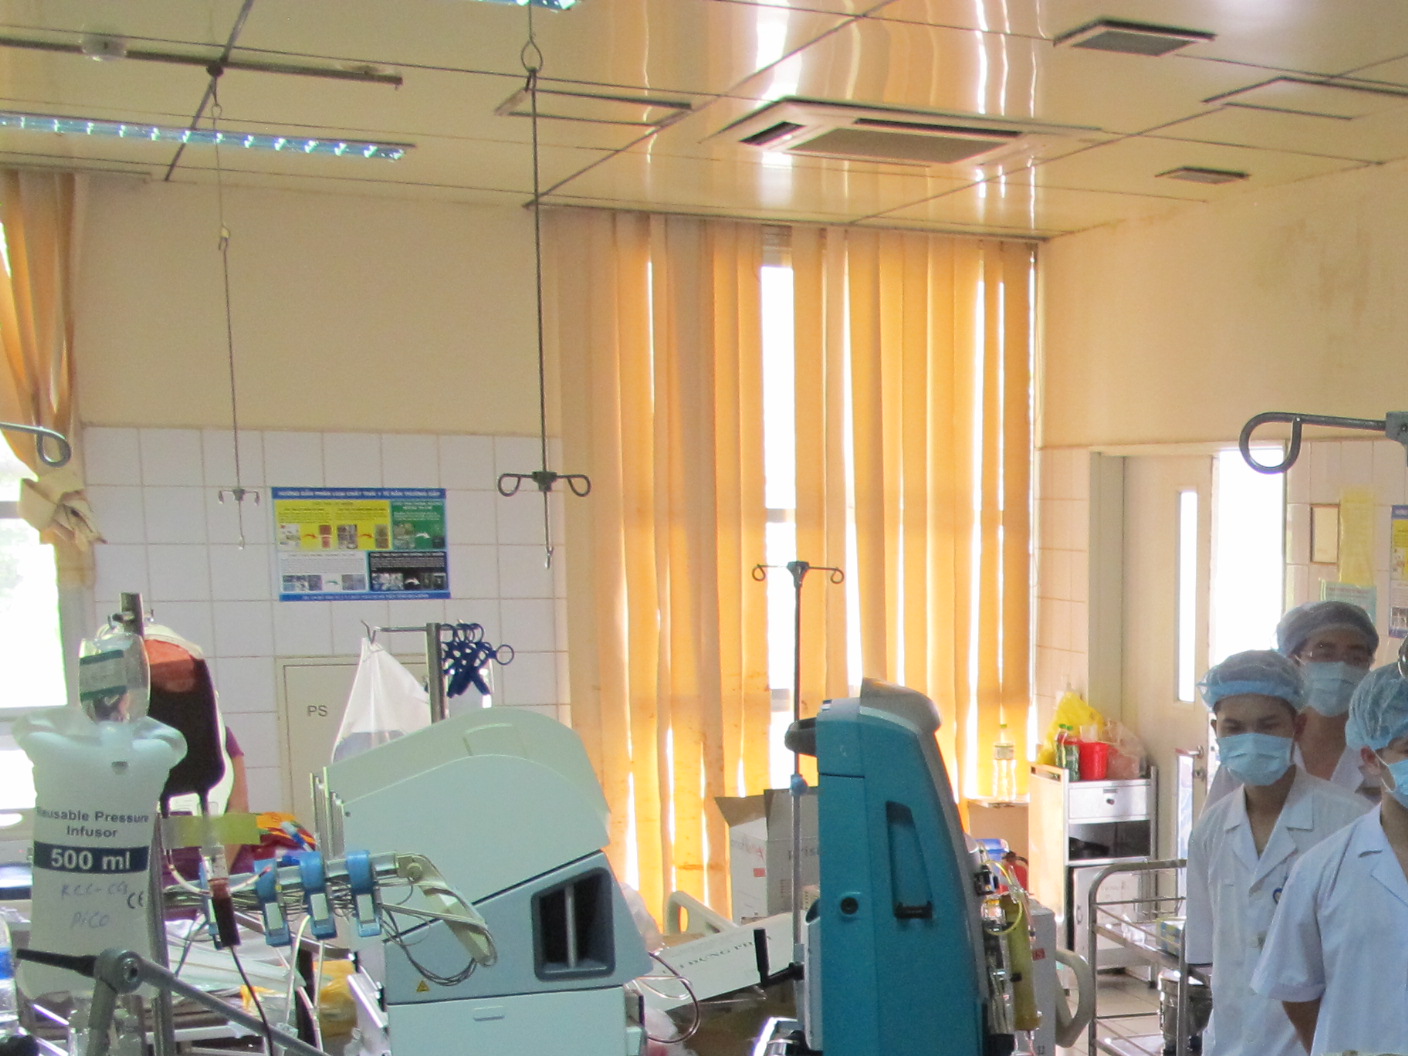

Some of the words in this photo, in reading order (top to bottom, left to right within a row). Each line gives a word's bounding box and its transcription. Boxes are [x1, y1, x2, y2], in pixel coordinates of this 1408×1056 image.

[307, 704, 328, 717] PS
[66, 825, 118, 838] Infusor
[50, 848, 94, 871] 500
[101, 850, 131, 871] ml
